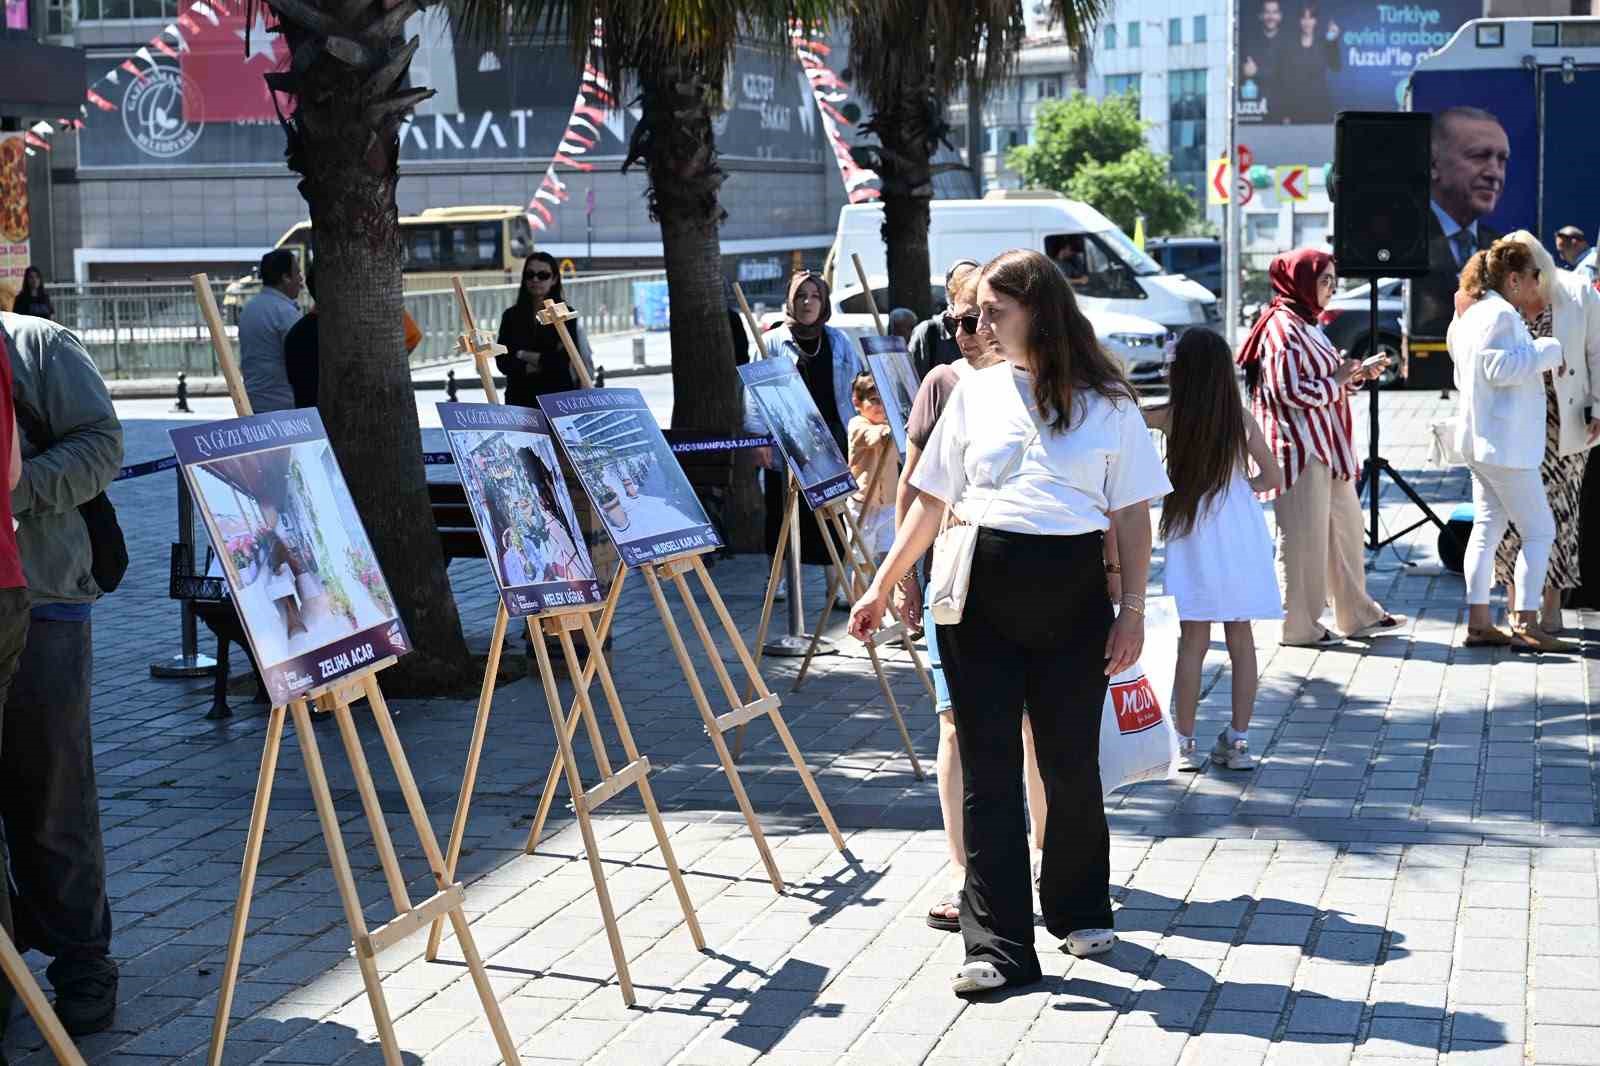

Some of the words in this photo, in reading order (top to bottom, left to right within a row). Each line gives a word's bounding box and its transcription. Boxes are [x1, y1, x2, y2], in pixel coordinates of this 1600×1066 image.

[1377, 4, 1440, 32] Türkiye
[1344, 26, 1385, 46] evini
[680, 535, 705, 550] KAPLAN
[543, 590, 566, 606] MELEK
[351, 643, 375, 666] ACAR
